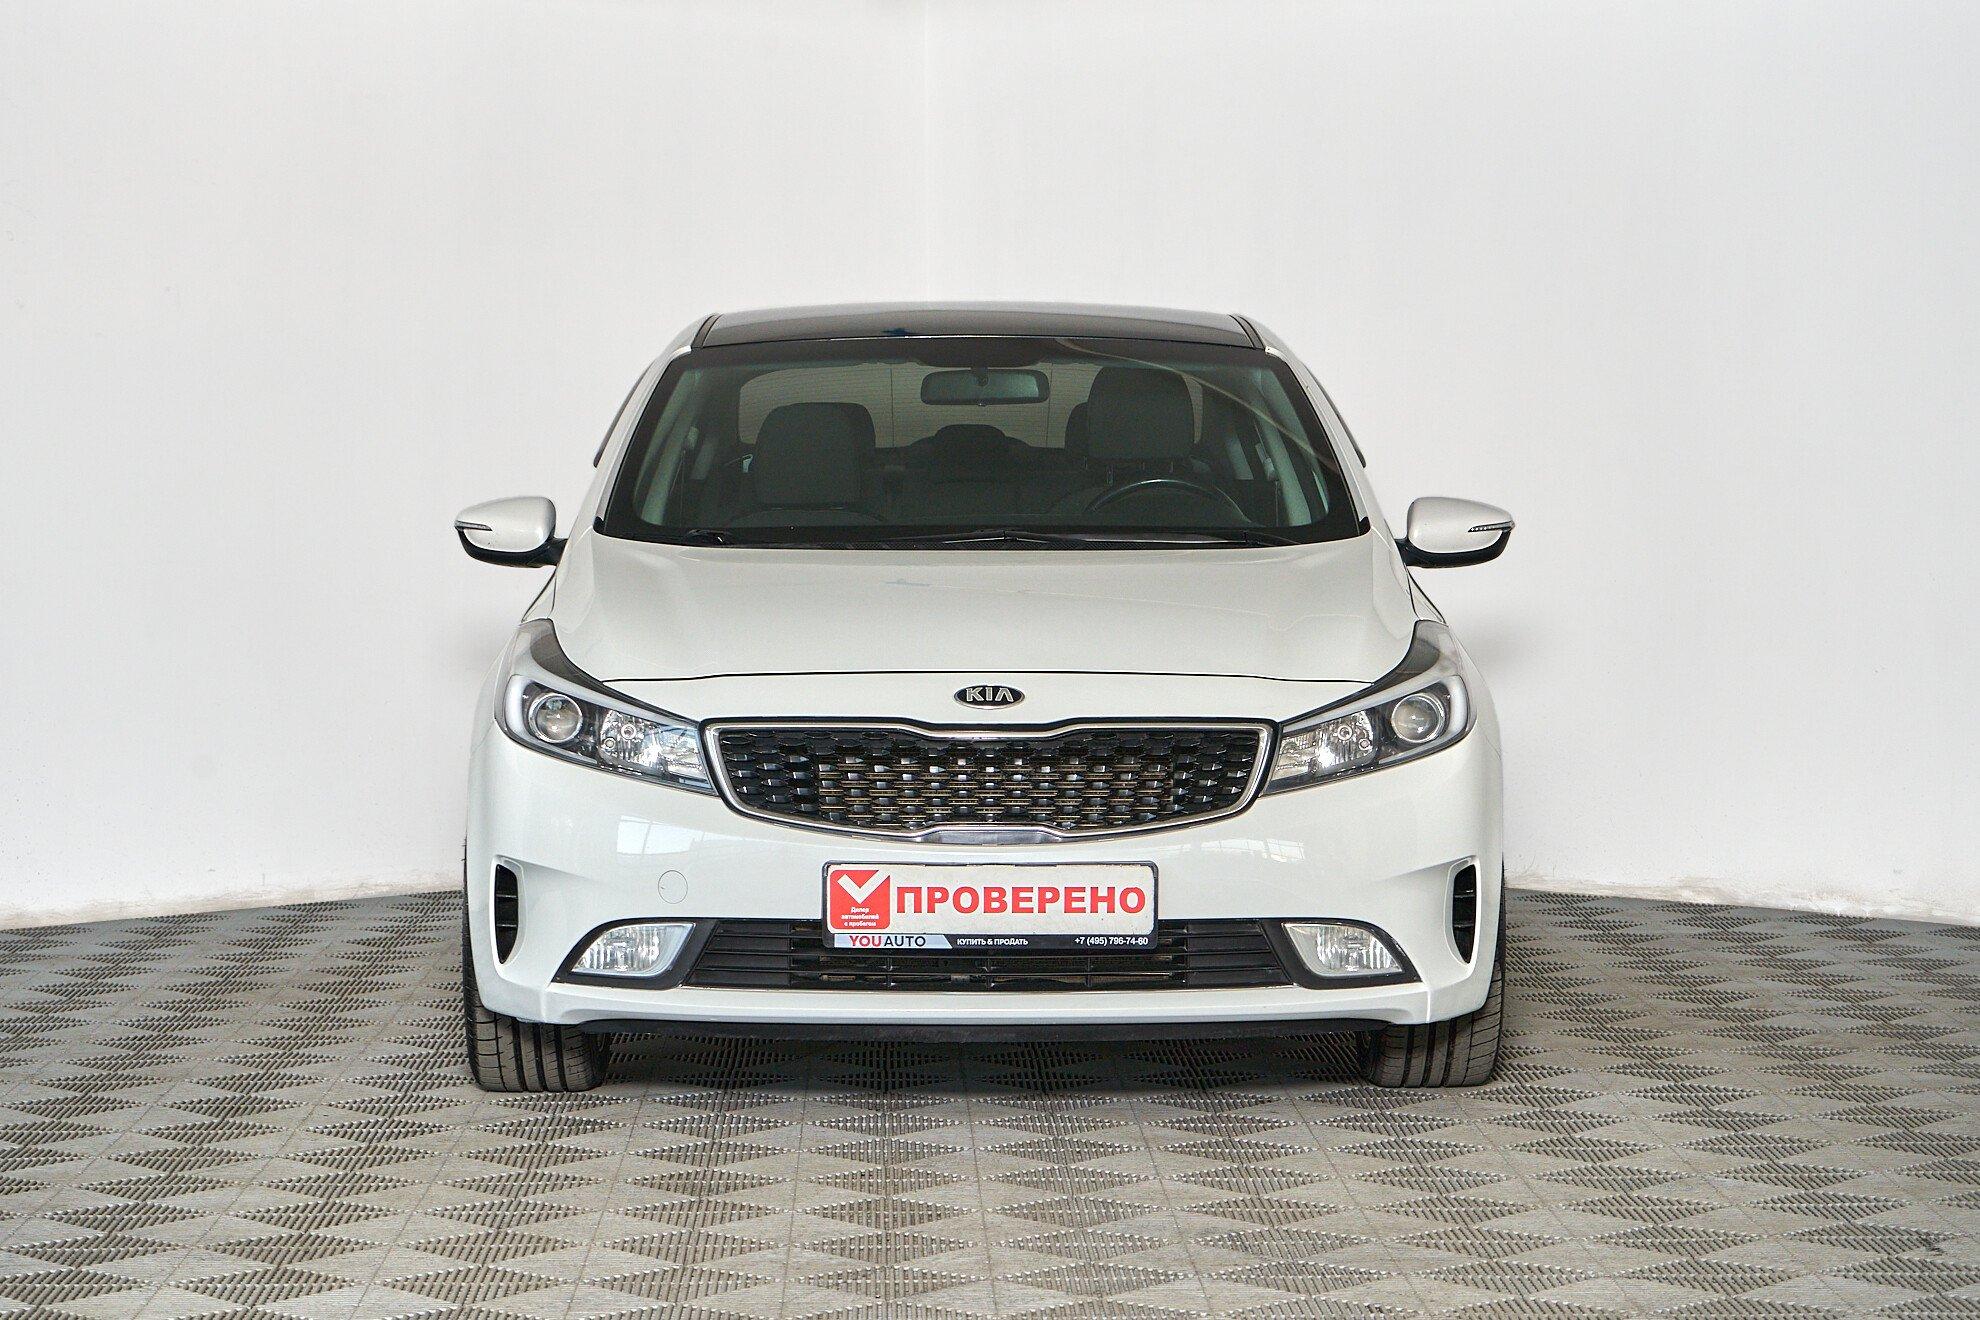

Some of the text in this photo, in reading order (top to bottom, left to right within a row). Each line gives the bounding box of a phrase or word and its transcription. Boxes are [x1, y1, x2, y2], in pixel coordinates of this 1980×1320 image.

[965, 687, 1014, 702] KIA
[896, 886, 1146, 914] ПРОВЕРЕНО
[956, 938, 986, 946] КУПИТЬ
[994, 938, 1029, 946] ПРОДАТЬ
[1074, 936, 1149, 946] +7 (495) 796-74-60
